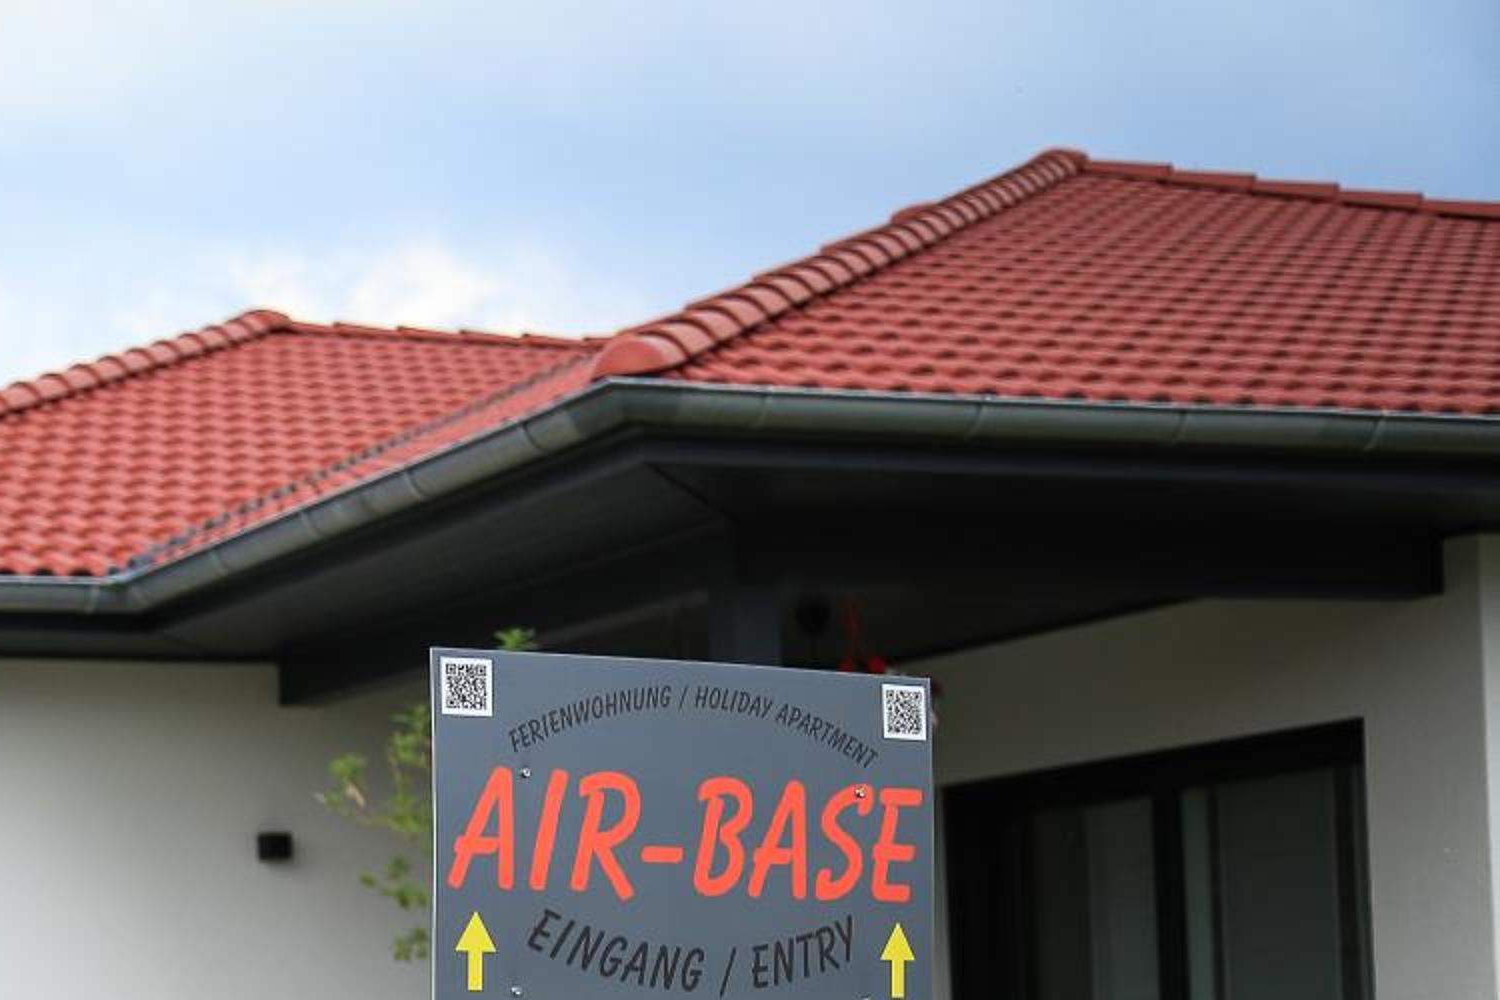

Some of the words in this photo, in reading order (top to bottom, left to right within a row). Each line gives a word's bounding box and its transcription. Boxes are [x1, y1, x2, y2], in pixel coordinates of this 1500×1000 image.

[508, 686, 672, 752] FERIENWOHNUNG
[679, 687, 690, 713] /
[695, 686, 773, 721] HOLIDAY
[775, 702, 879, 769] APARTMENT
[447, 766, 924, 904] AIR-BASE
[527, 909, 705, 992] EINGANG
[720, 949, 737, 998] /
[752, 915, 855, 989] ENTRY
